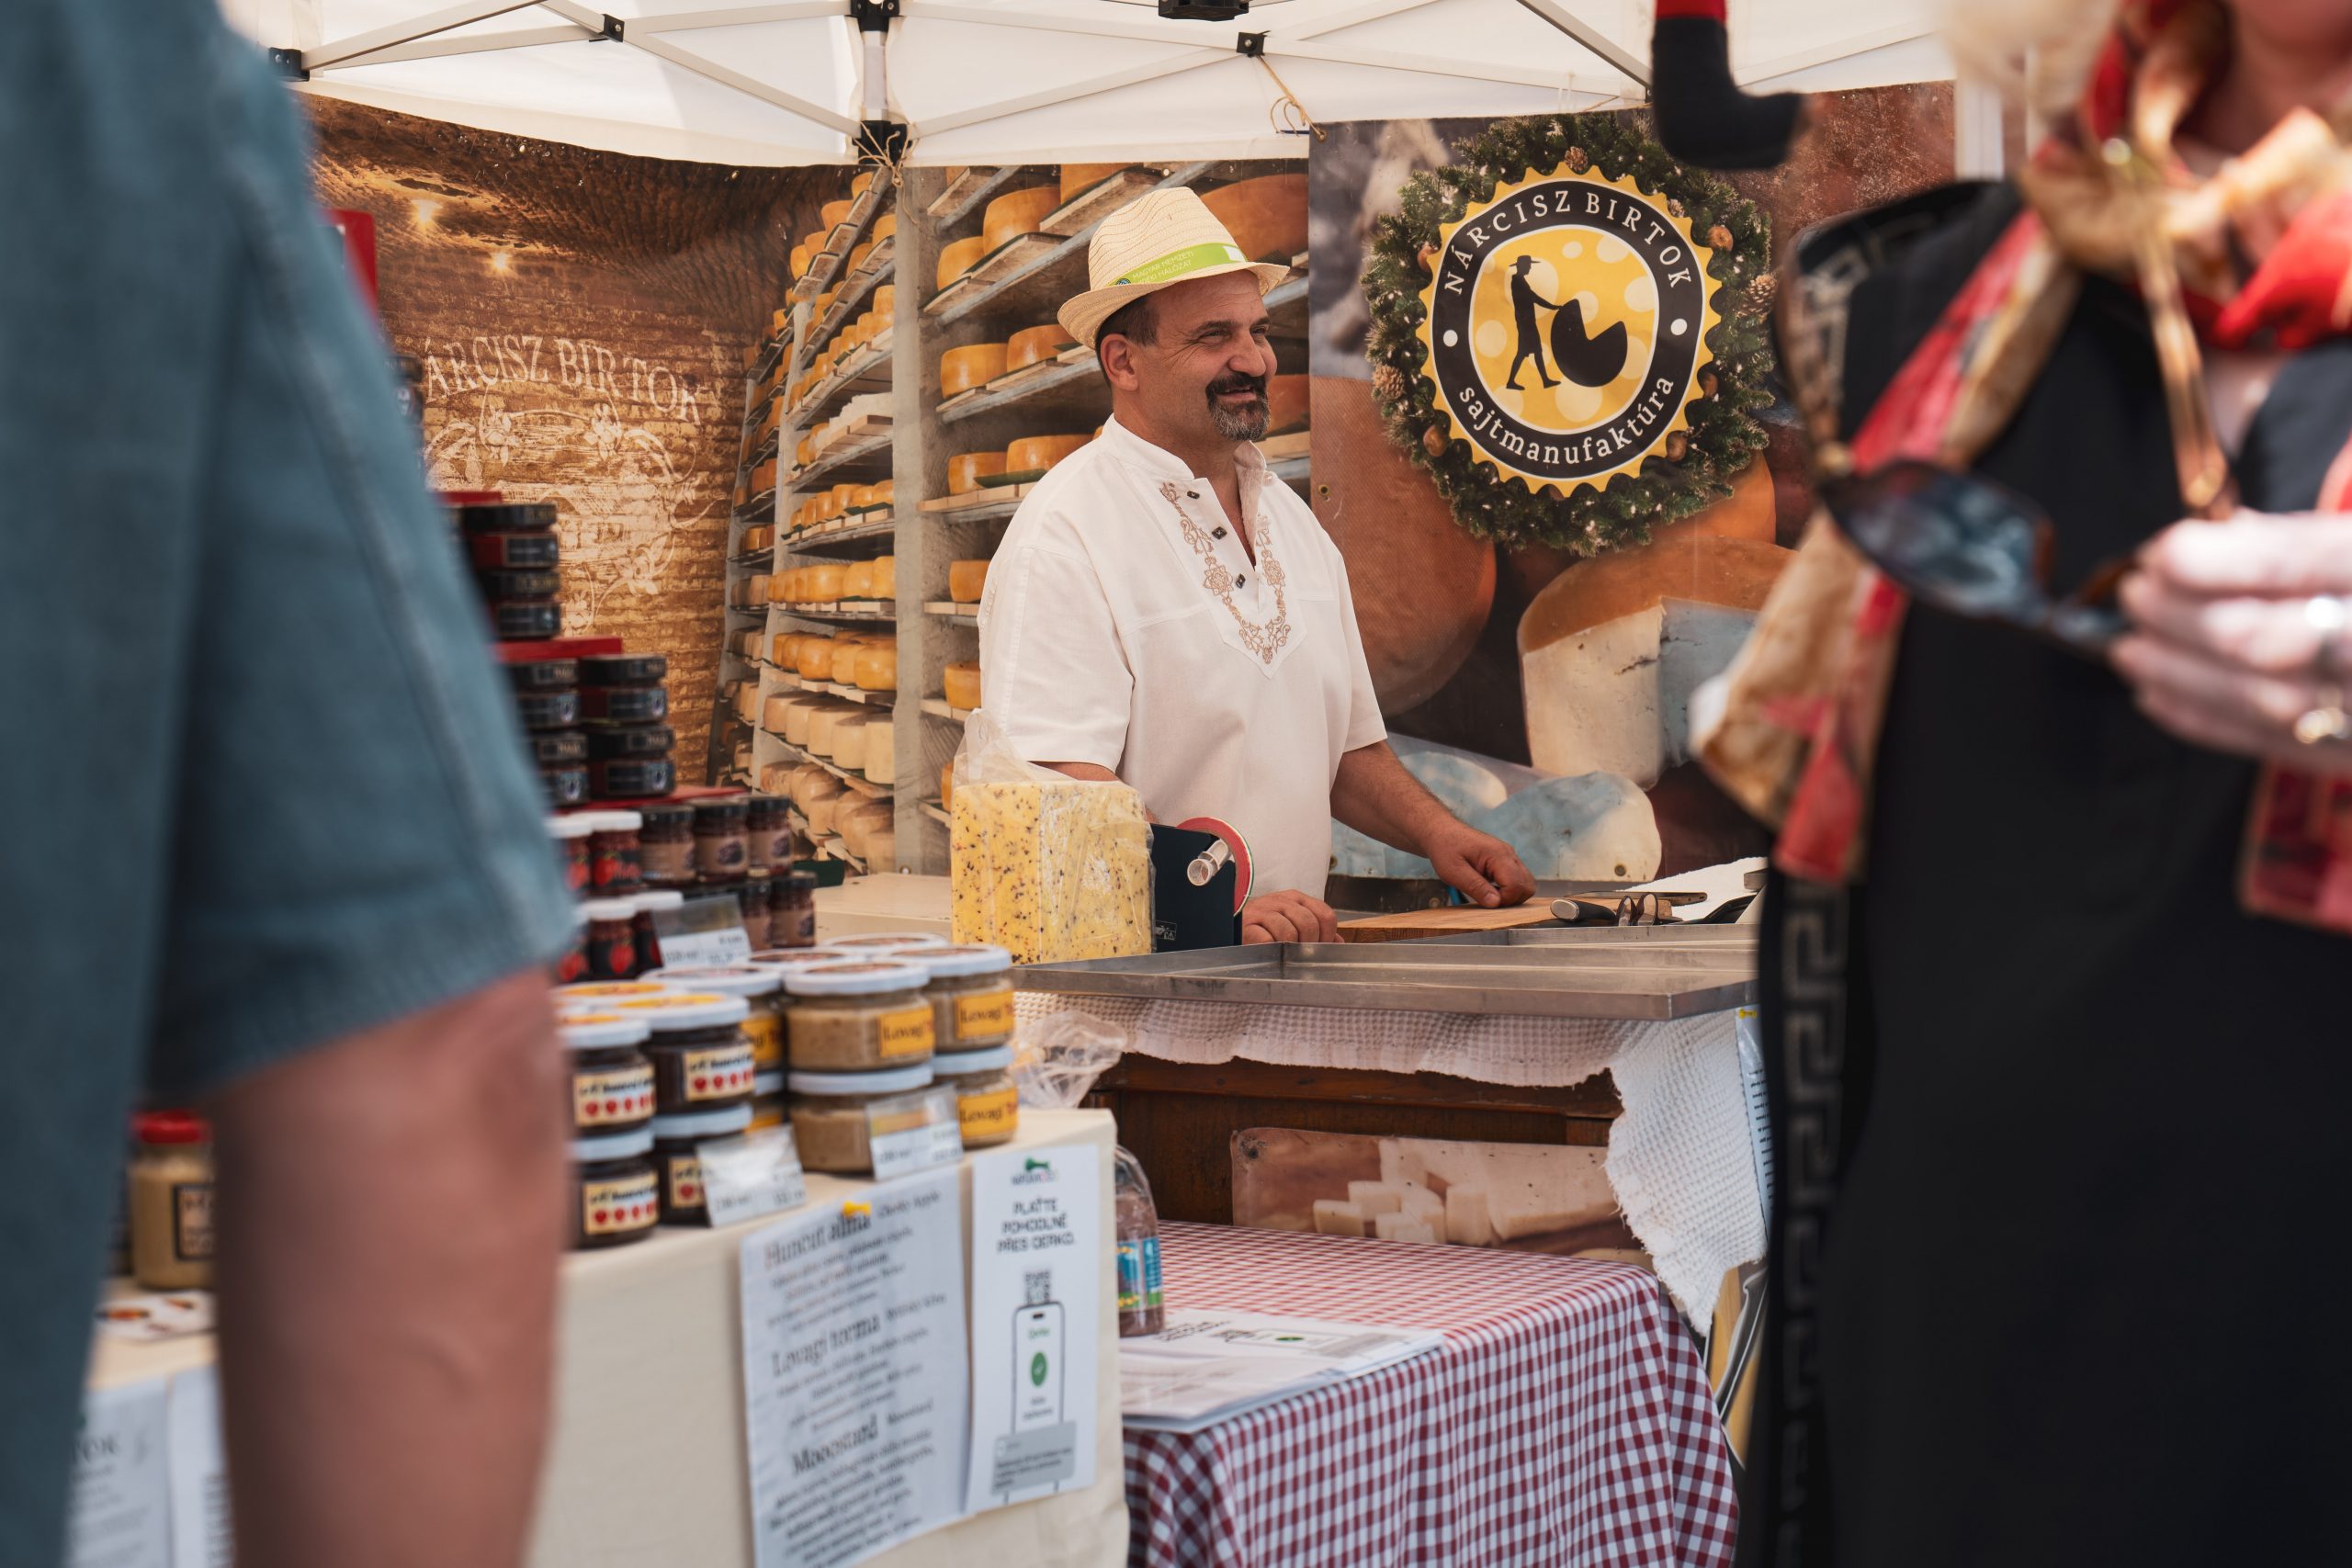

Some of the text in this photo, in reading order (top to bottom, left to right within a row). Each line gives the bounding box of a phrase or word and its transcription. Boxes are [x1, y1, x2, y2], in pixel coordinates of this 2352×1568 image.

[1132, 251, 1194, 280] MAGYAR NEMZETI
[1444, 189, 1692, 296] NÁRCISZ BIRTOK
[424, 335, 706, 426] ÁRCISZ BIRTOK
[1458, 376, 1675, 466] sajtmanufaktúra
